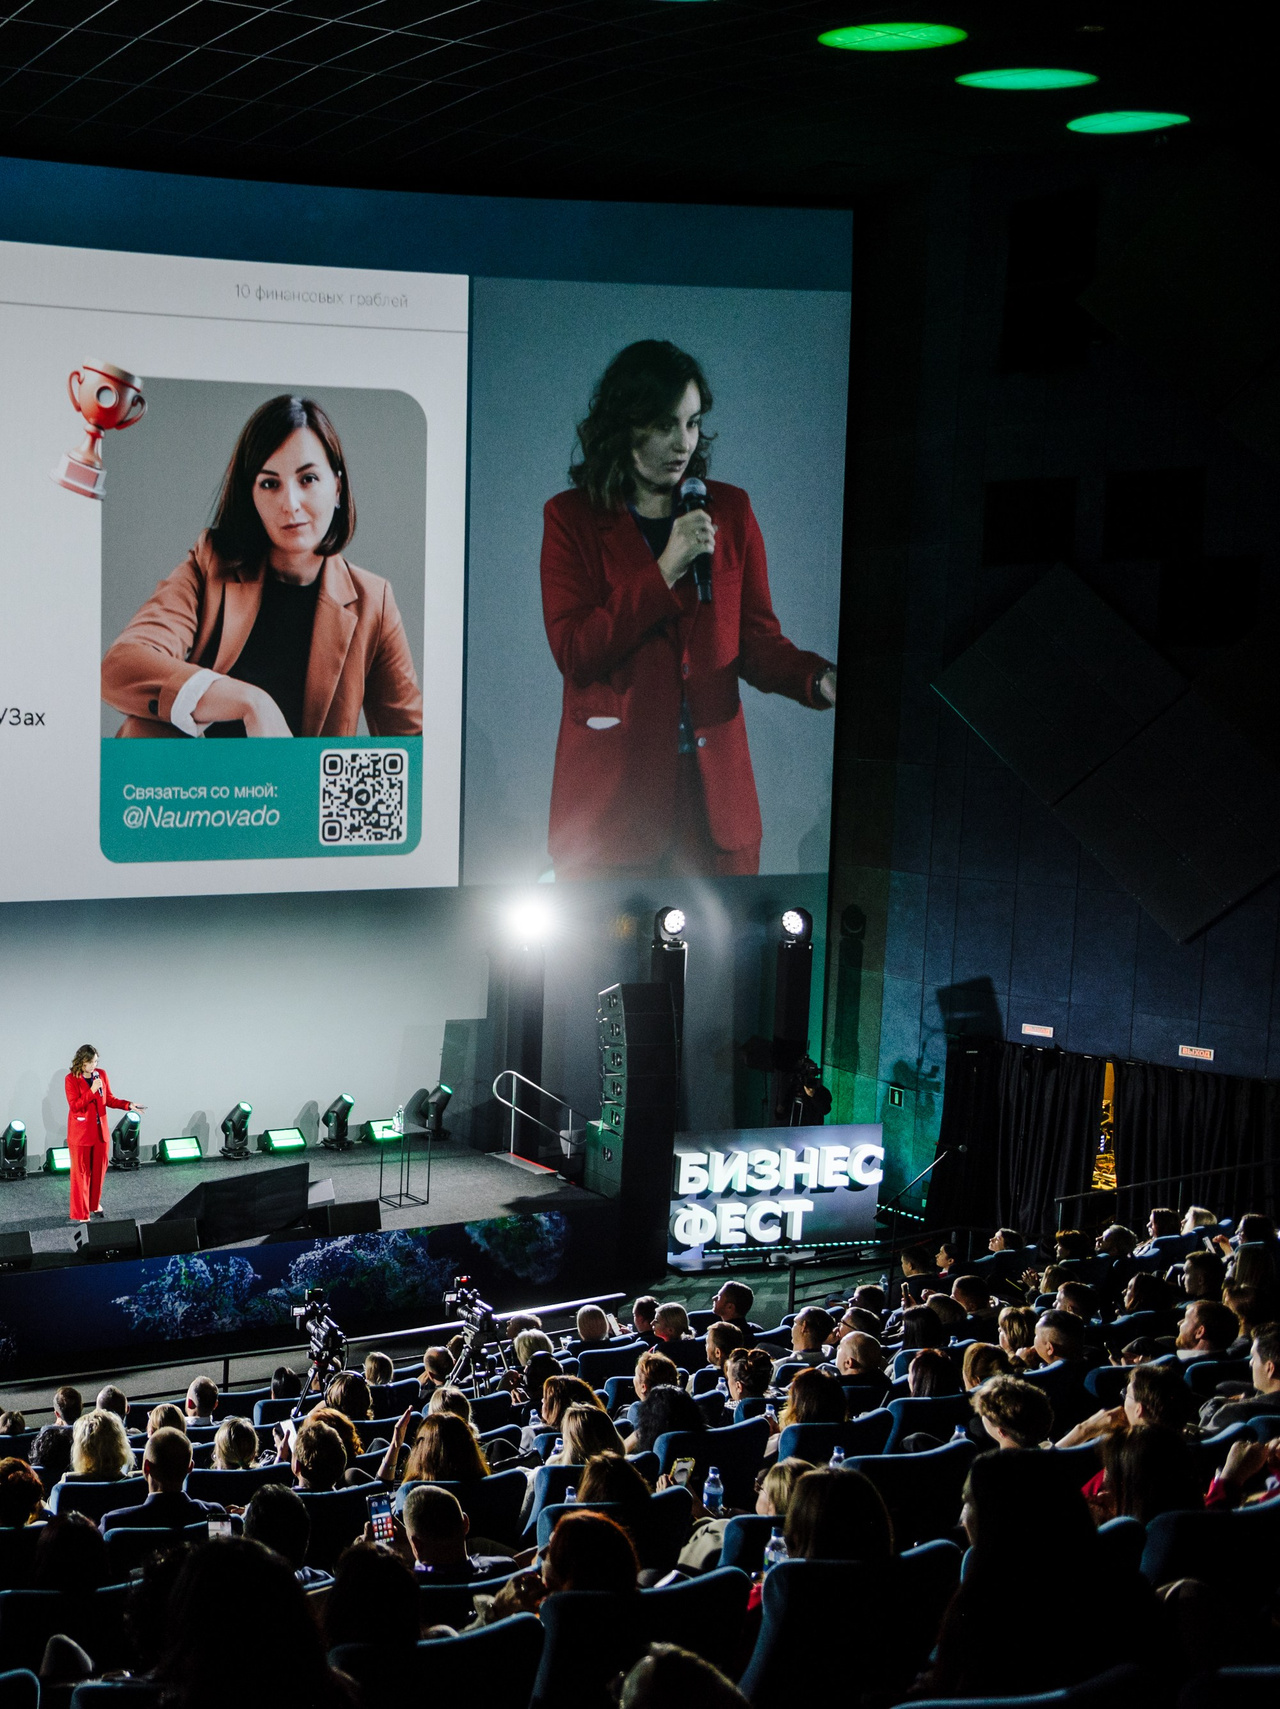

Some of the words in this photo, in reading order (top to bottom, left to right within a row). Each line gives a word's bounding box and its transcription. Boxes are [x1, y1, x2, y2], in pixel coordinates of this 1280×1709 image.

[235, 284, 250, 298] 10
[255, 284, 344, 305] финансовых
[123, 784, 207, 800] Связаться
[210, 786, 230, 799] со
[234, 783, 277, 798] мной:
[123, 805, 280, 828] @Naumovado
[1181, 1046, 1212, 1059] ВЫХОД
[673, 1143, 886, 1196] БИЗНЕС
[670, 1198, 815, 1248] ФЕСТ
